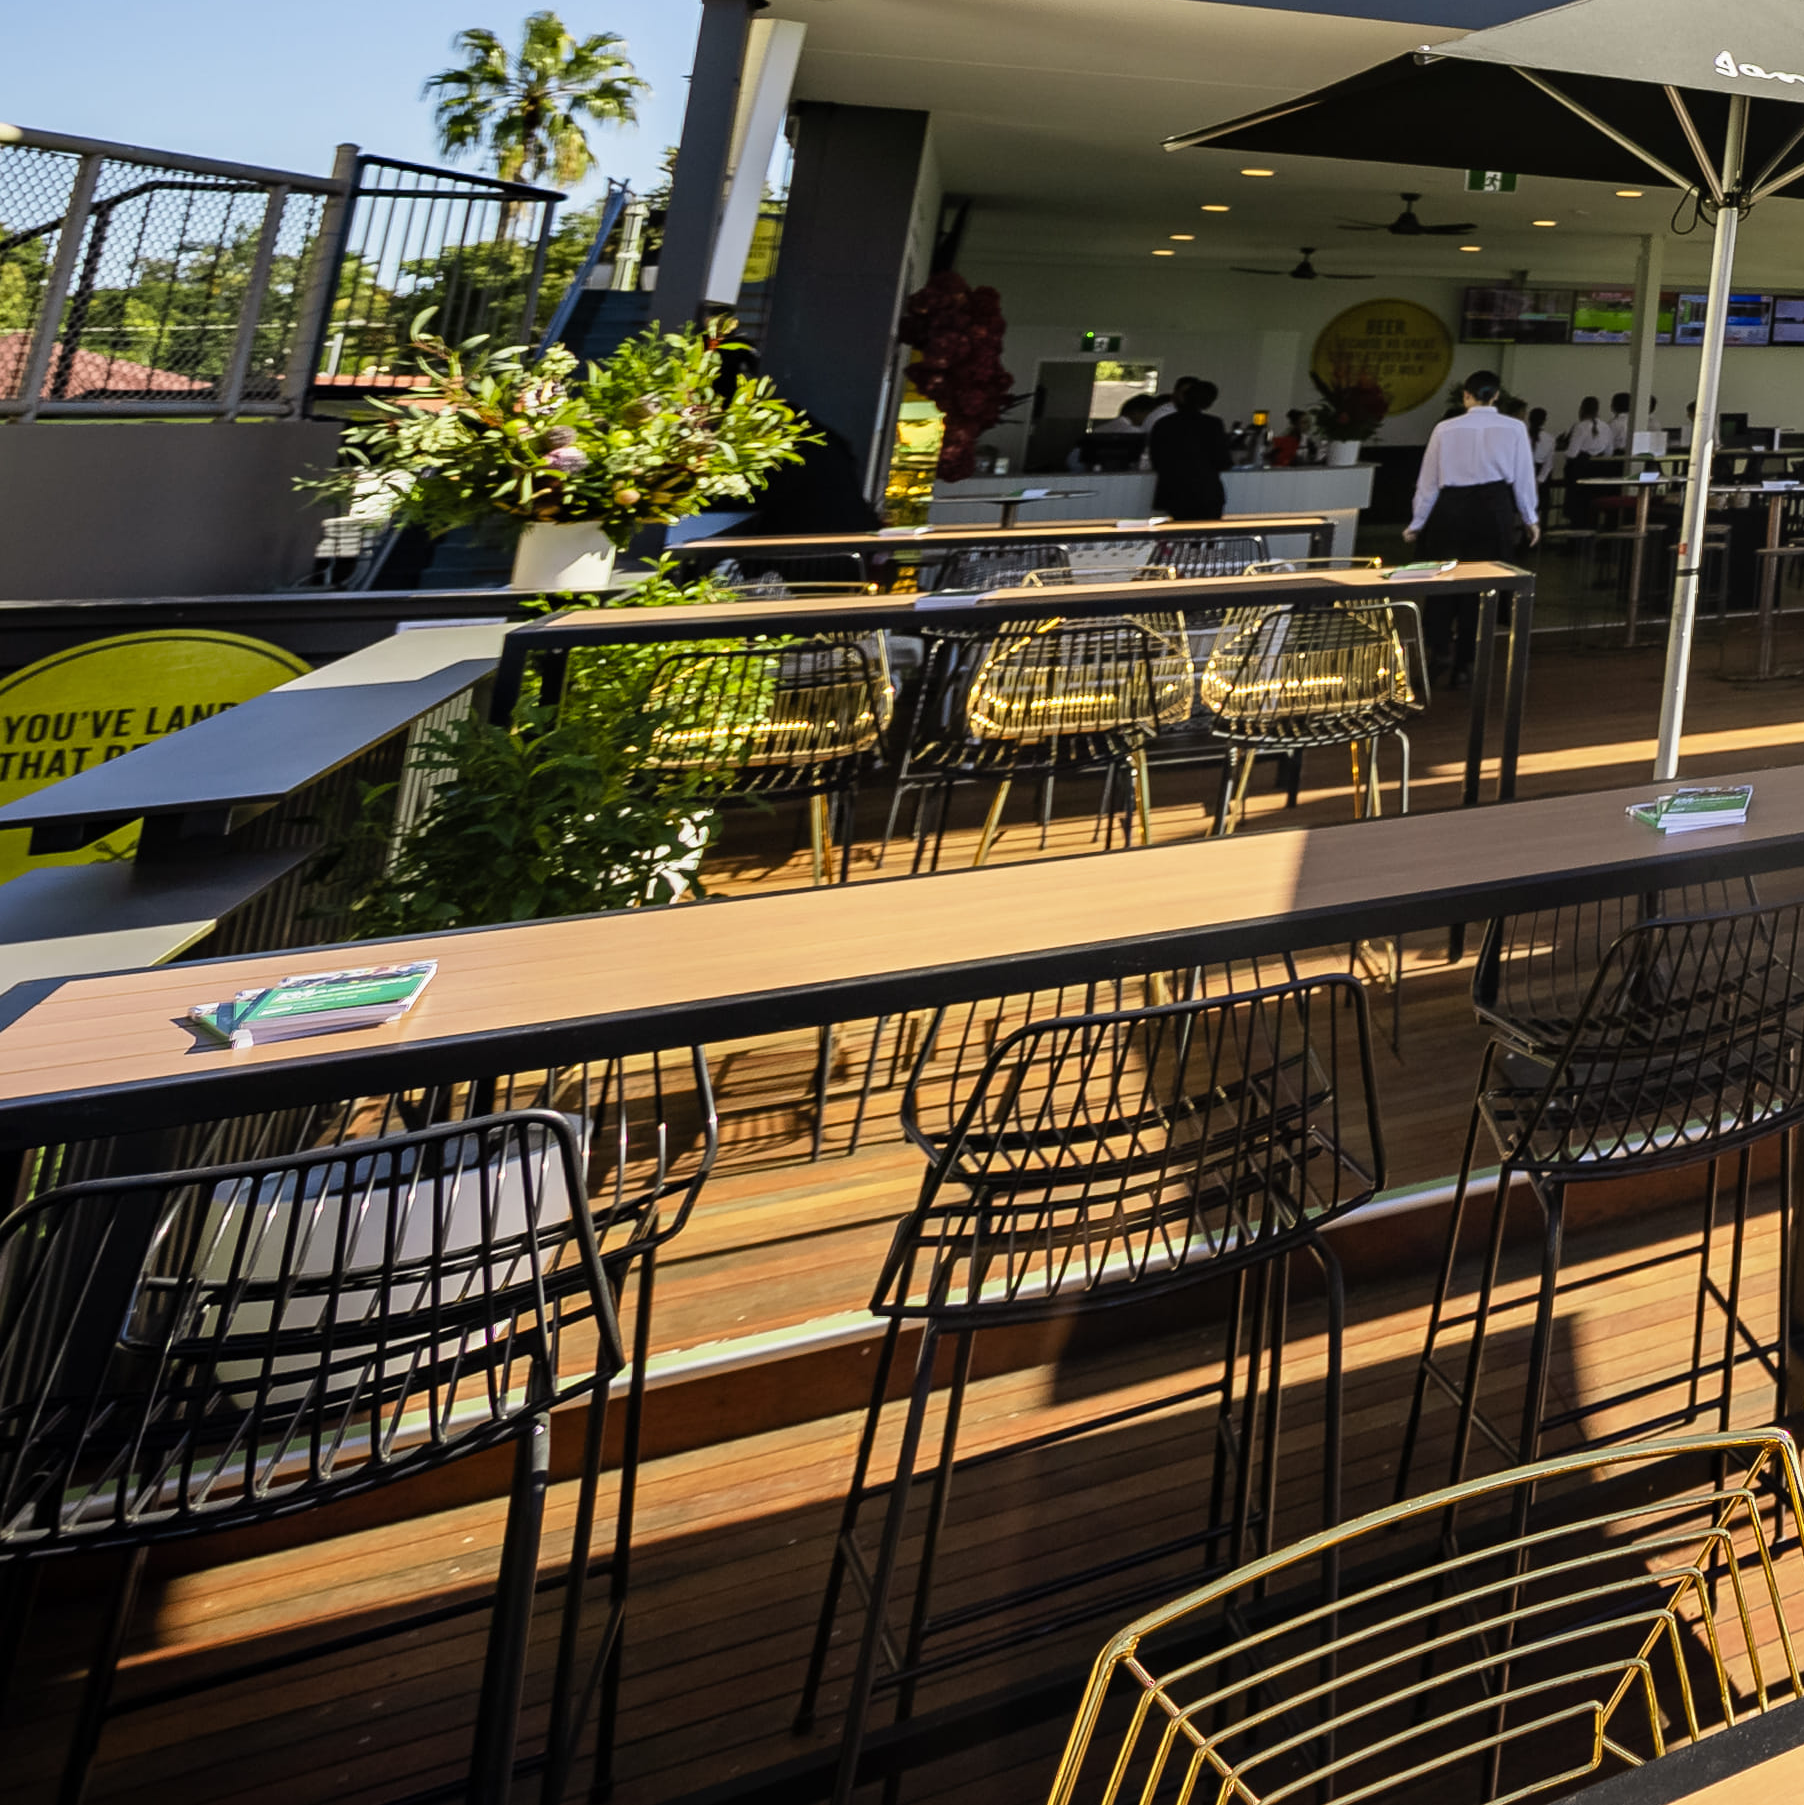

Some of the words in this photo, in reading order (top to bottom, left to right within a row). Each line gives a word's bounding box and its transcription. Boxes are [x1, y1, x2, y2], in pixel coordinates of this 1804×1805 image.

[4, 708, 136, 745] YOU'VE
[145, 702, 239, 736] LAN
[0, 747, 93, 782] THAT
